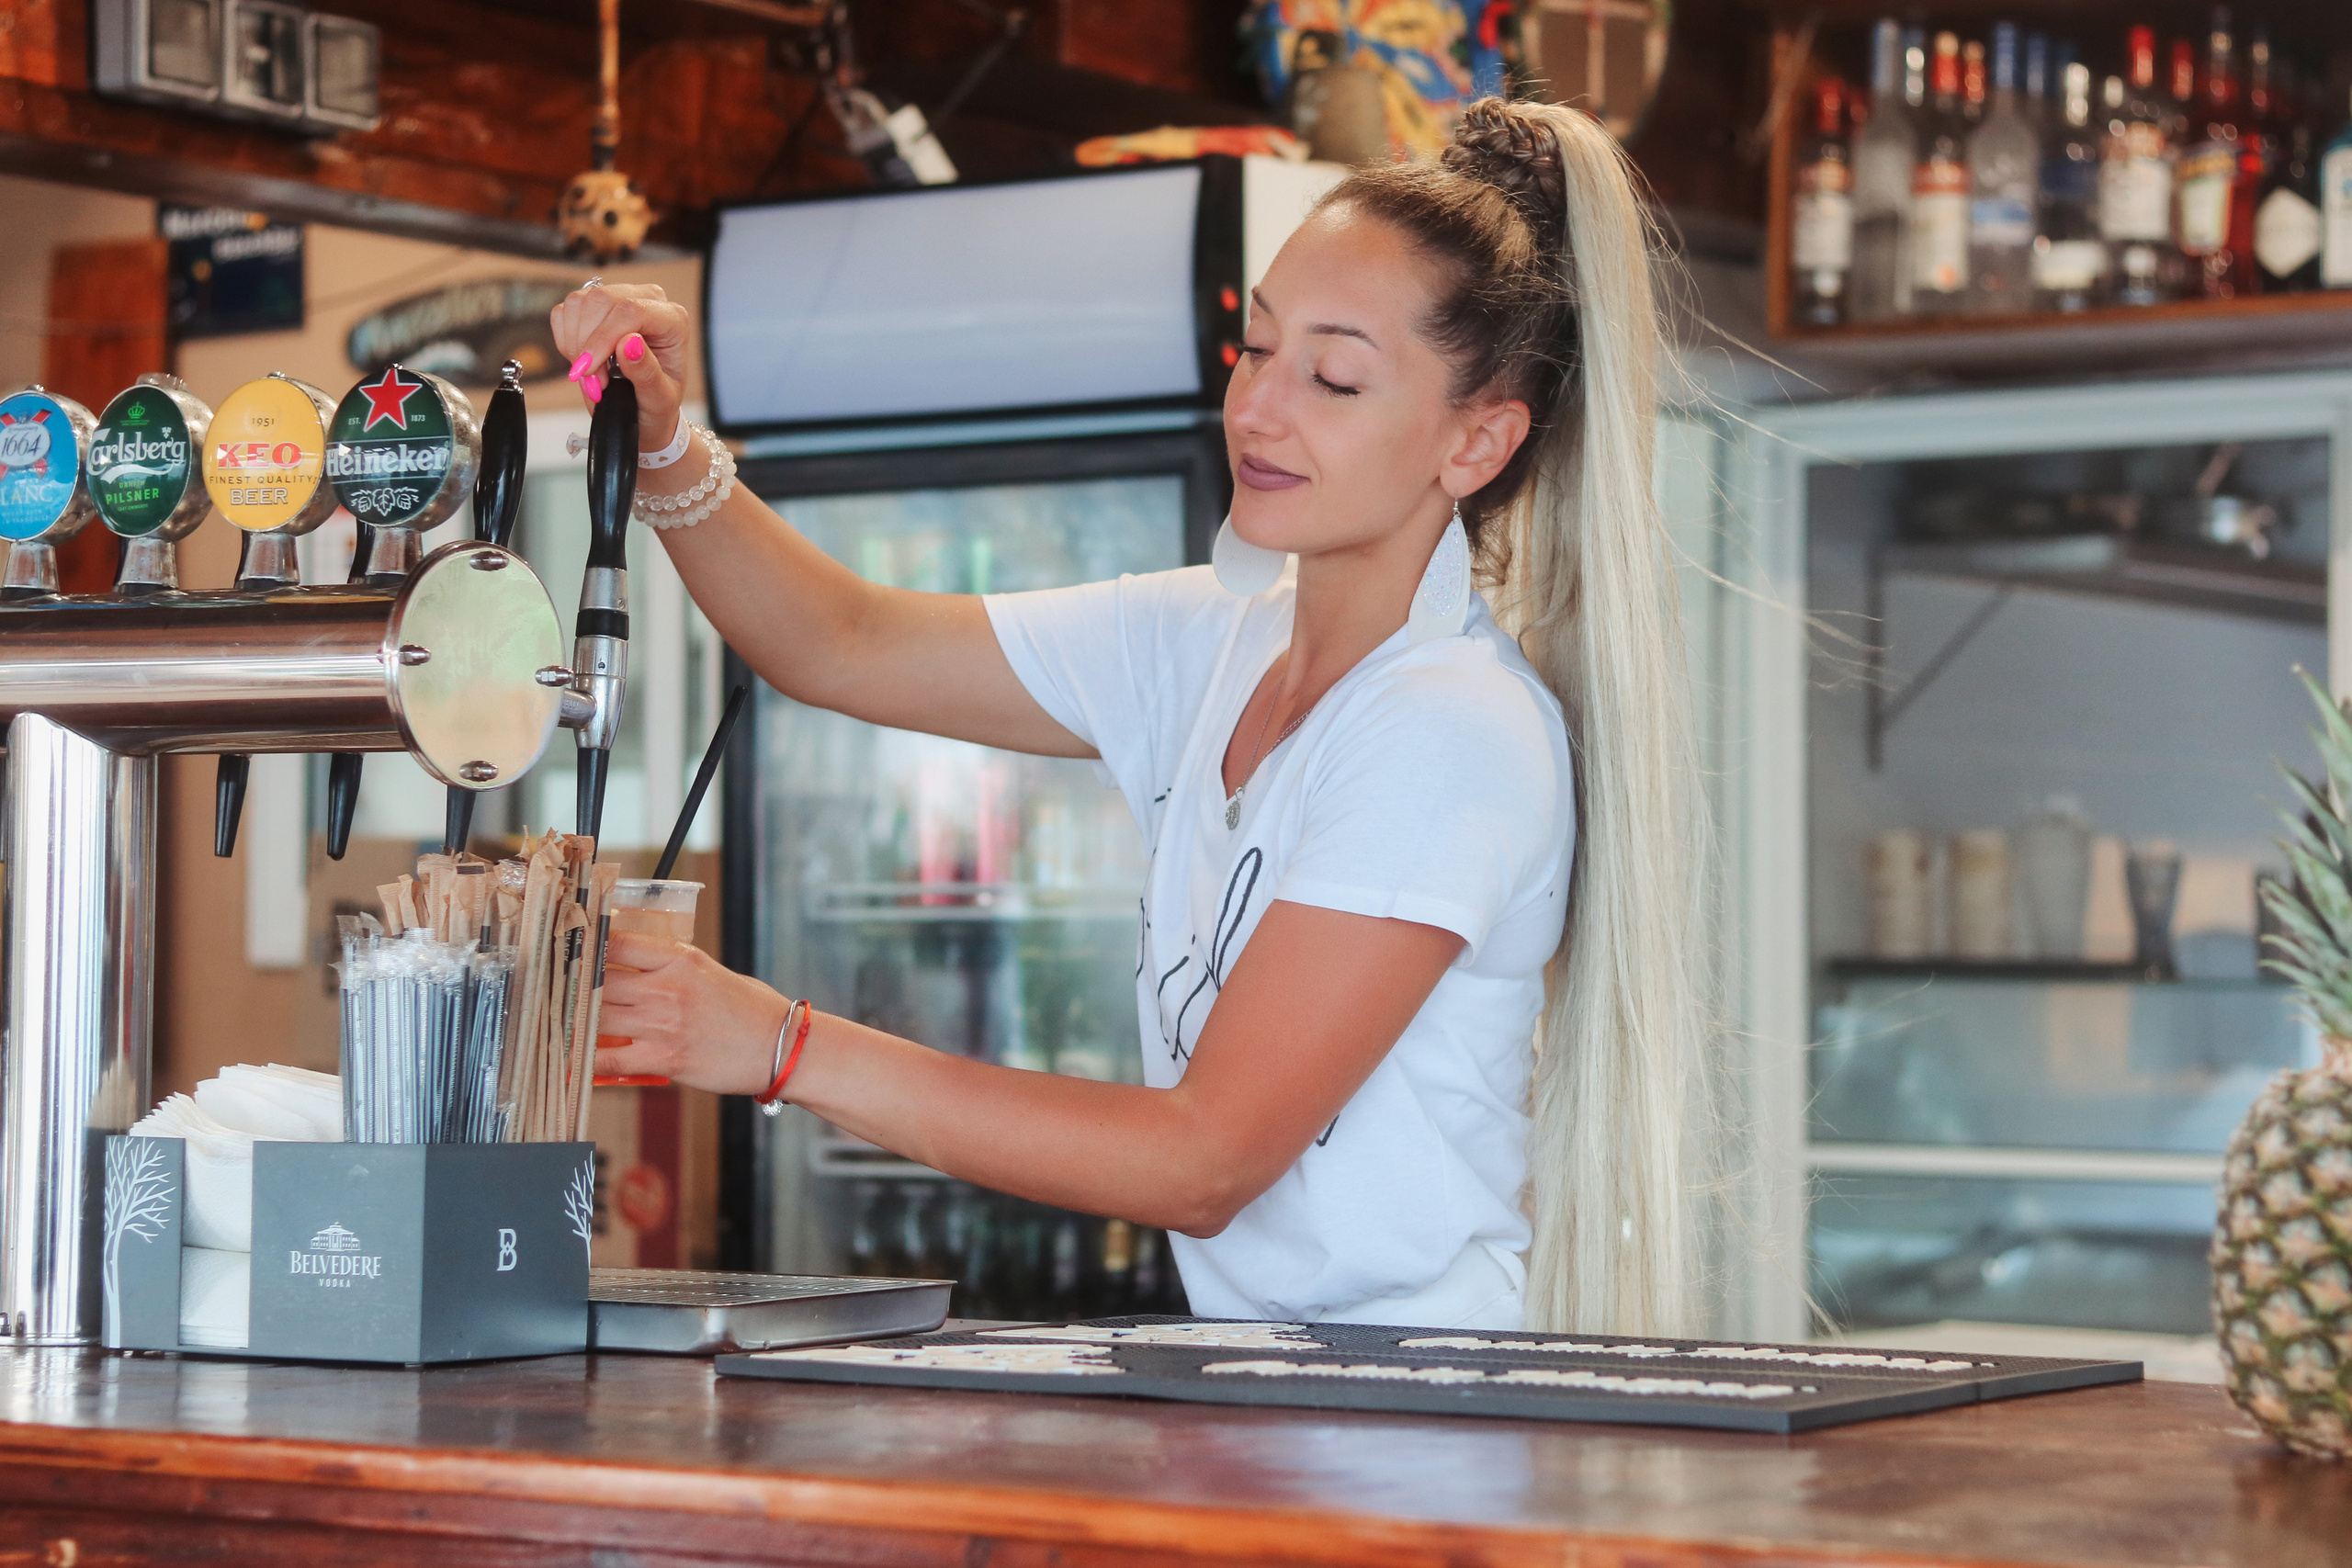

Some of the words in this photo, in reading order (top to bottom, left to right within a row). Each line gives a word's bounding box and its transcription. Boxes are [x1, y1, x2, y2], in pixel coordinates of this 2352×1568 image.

[252, 418, 275, 427] 1951
[1, 432, 41, 457] 1664
[86, 428, 187, 476] Carlsberg
[217, 442, 302, 469] KEO
[325, 444, 450, 477] Heineken
[209, 476, 251, 485] FINEST
[257, 475, 313, 485] QUALITY
[0, 485, 52, 505] LANC
[106, 488, 159, 505] PILSNER
[230, 488, 288, 505] BEER
[571, 977, 579, 992] NO
[568, 993, 577, 1020] MORE
[564, 1021, 573, 1059] PLASTIC
[289, 1251, 382, 1279] BELVEDERE
[319, 1279, 351, 1288] VODKA
